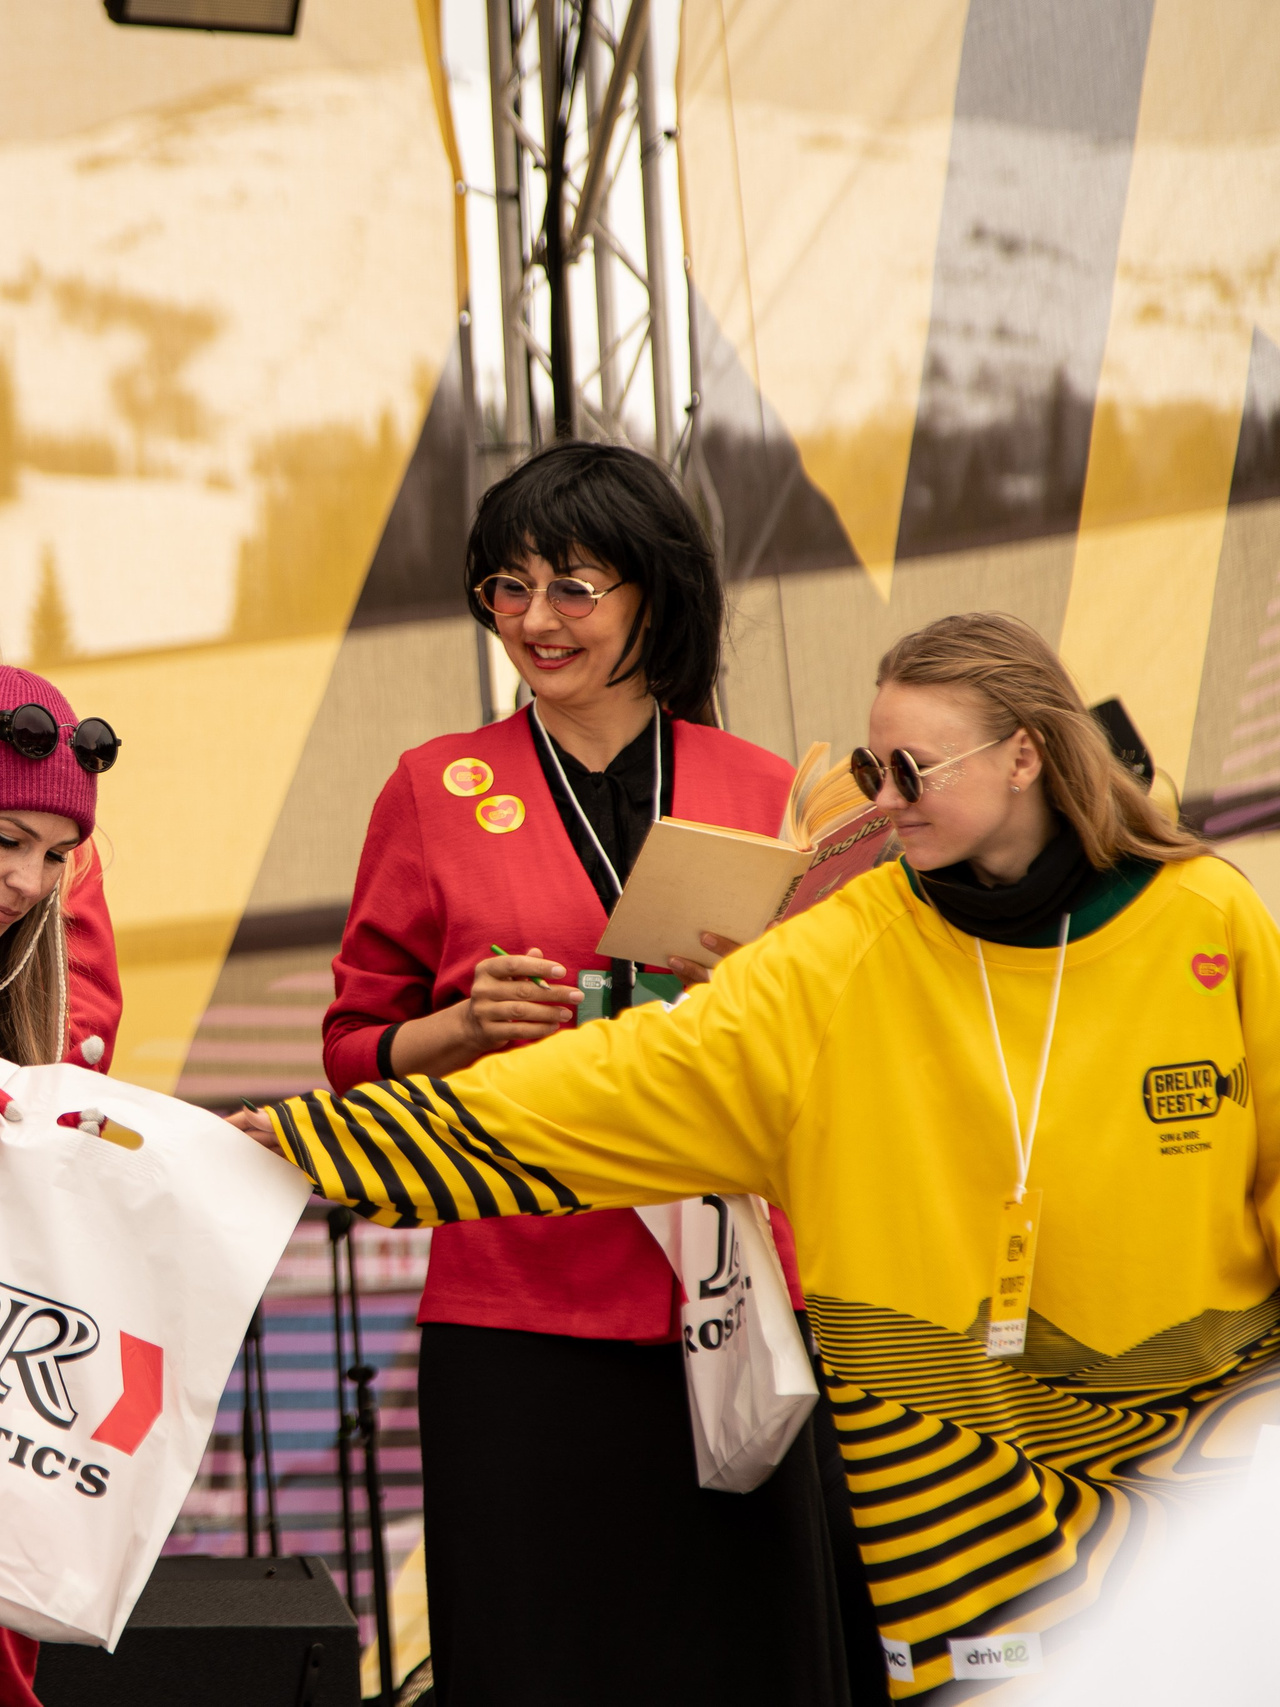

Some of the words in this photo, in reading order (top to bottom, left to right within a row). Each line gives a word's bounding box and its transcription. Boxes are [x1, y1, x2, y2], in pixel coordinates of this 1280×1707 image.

[1154, 1069, 1213, 1094] GRELKA
[1157, 1093, 1195, 1115] FEST
[966, 1644, 1030, 1665] drivee
